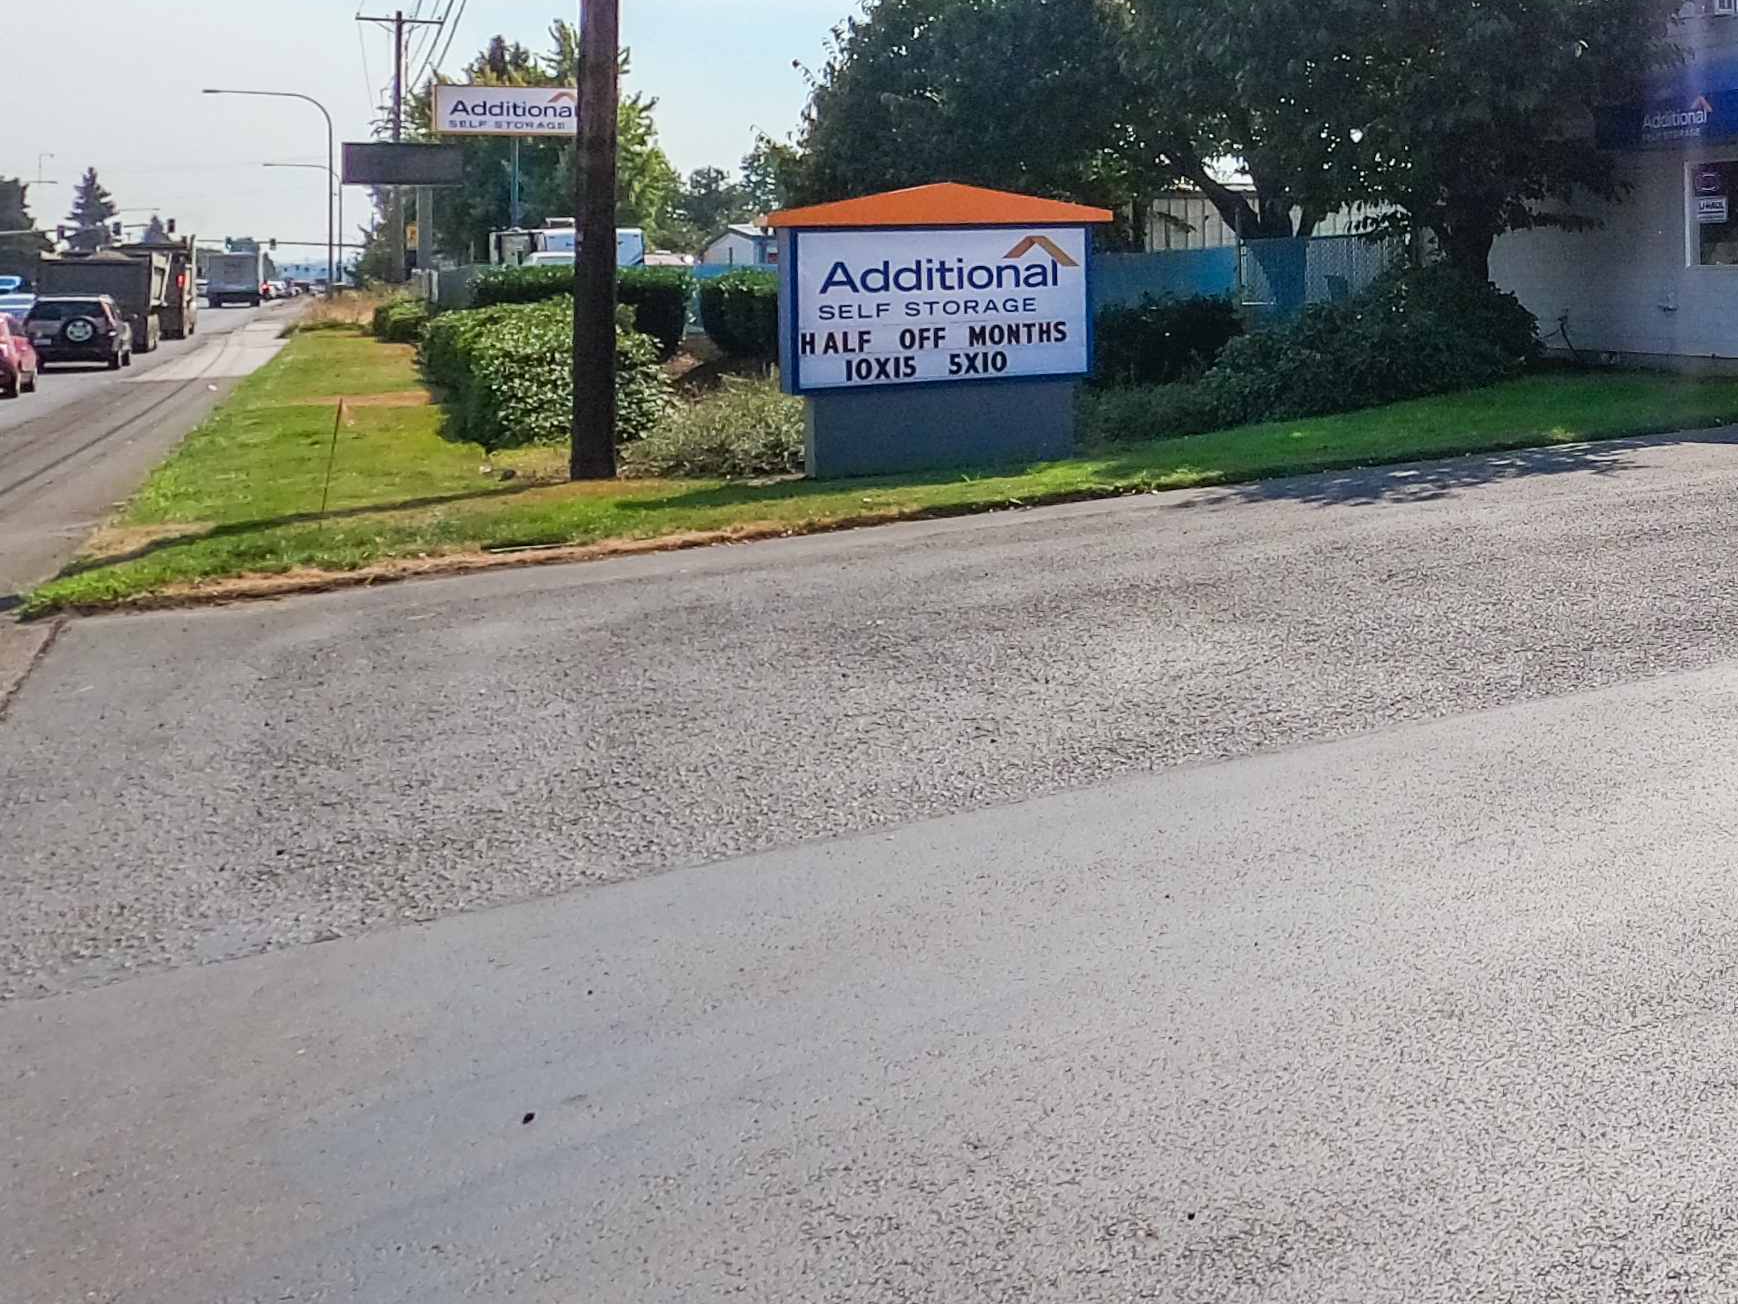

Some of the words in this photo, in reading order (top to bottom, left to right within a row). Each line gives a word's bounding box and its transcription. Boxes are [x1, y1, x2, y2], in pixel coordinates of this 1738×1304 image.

[448, 120, 488, 129] SELF
[494, 120, 566, 130] STORAGE
[1642, 108, 1707, 130] Additional
[818, 258, 1058, 295] Additional
[818, 303, 891, 321] SELF
[904, 298, 1037, 317] STORAGE
[800, 330, 871, 356] HALF
[899, 327, 946, 351] OFF
[969, 321, 1067, 348] MONTHS
[845, 356, 917, 382] 10X15
[948, 351, 1008, 376] 5X10
